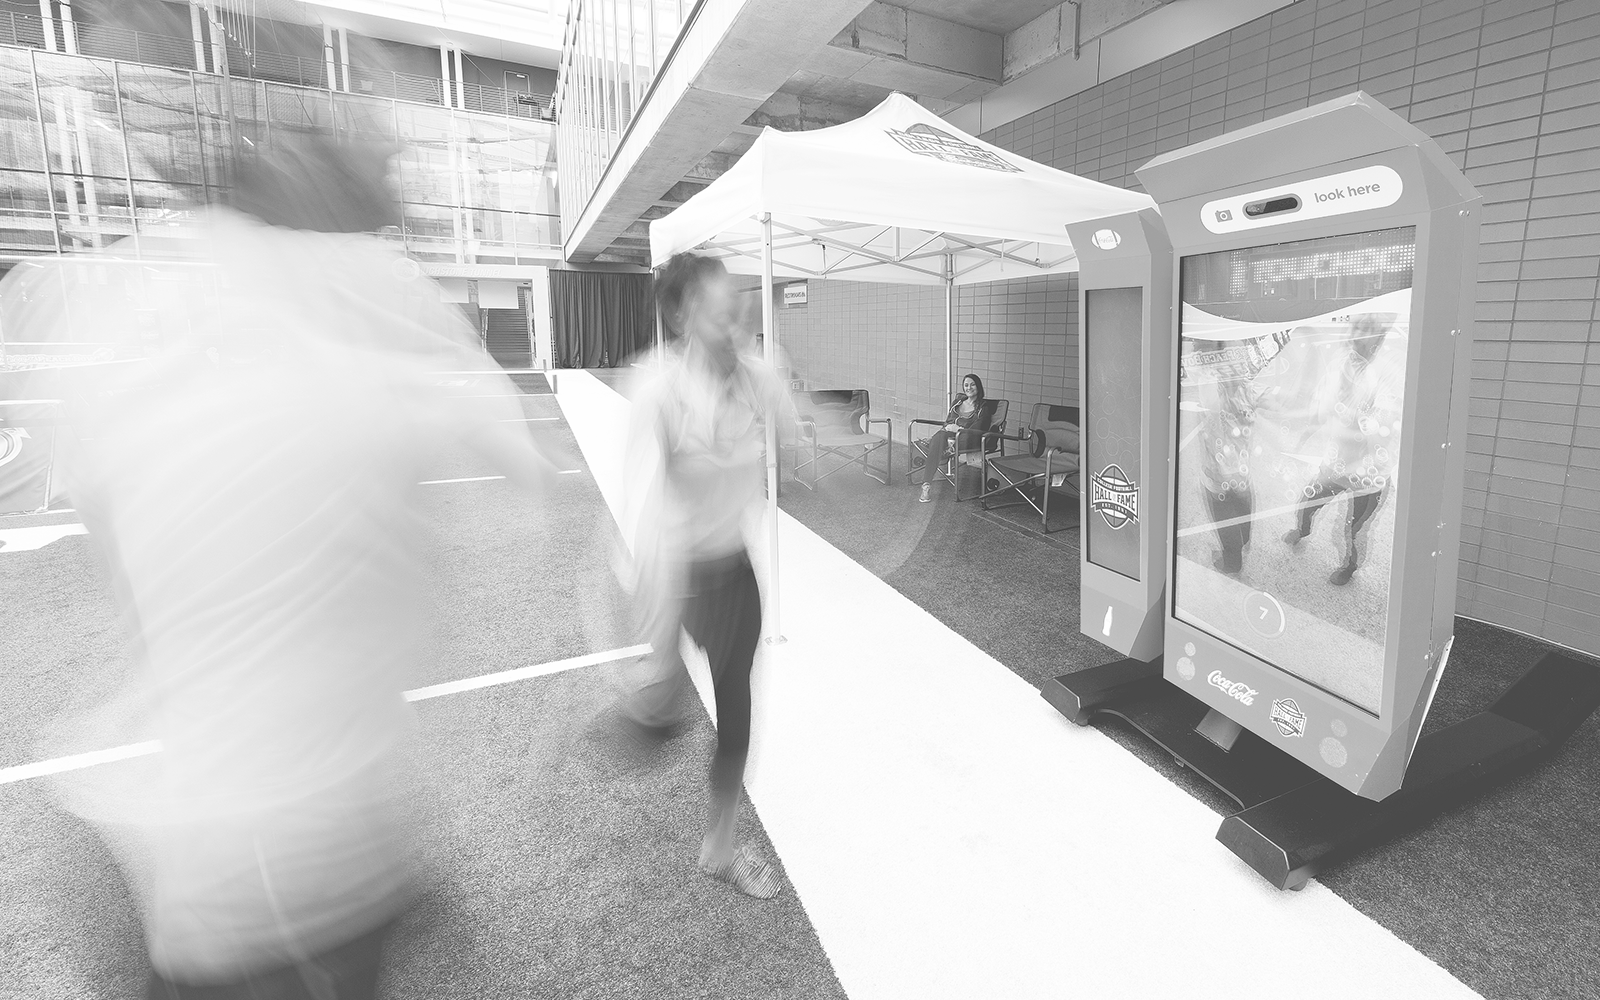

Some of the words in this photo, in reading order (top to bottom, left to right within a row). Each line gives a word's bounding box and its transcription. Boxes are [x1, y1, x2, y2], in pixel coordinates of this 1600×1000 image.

[1314, 188, 1346, 203] look
[1347, 182, 1381, 198] here
[1095, 484, 1112, 501] HALL
[1117, 494, 1136, 512] FAME
[1260, 606, 1268, 620] 7
[1207, 670, 1259, 706] Coca-Cola
